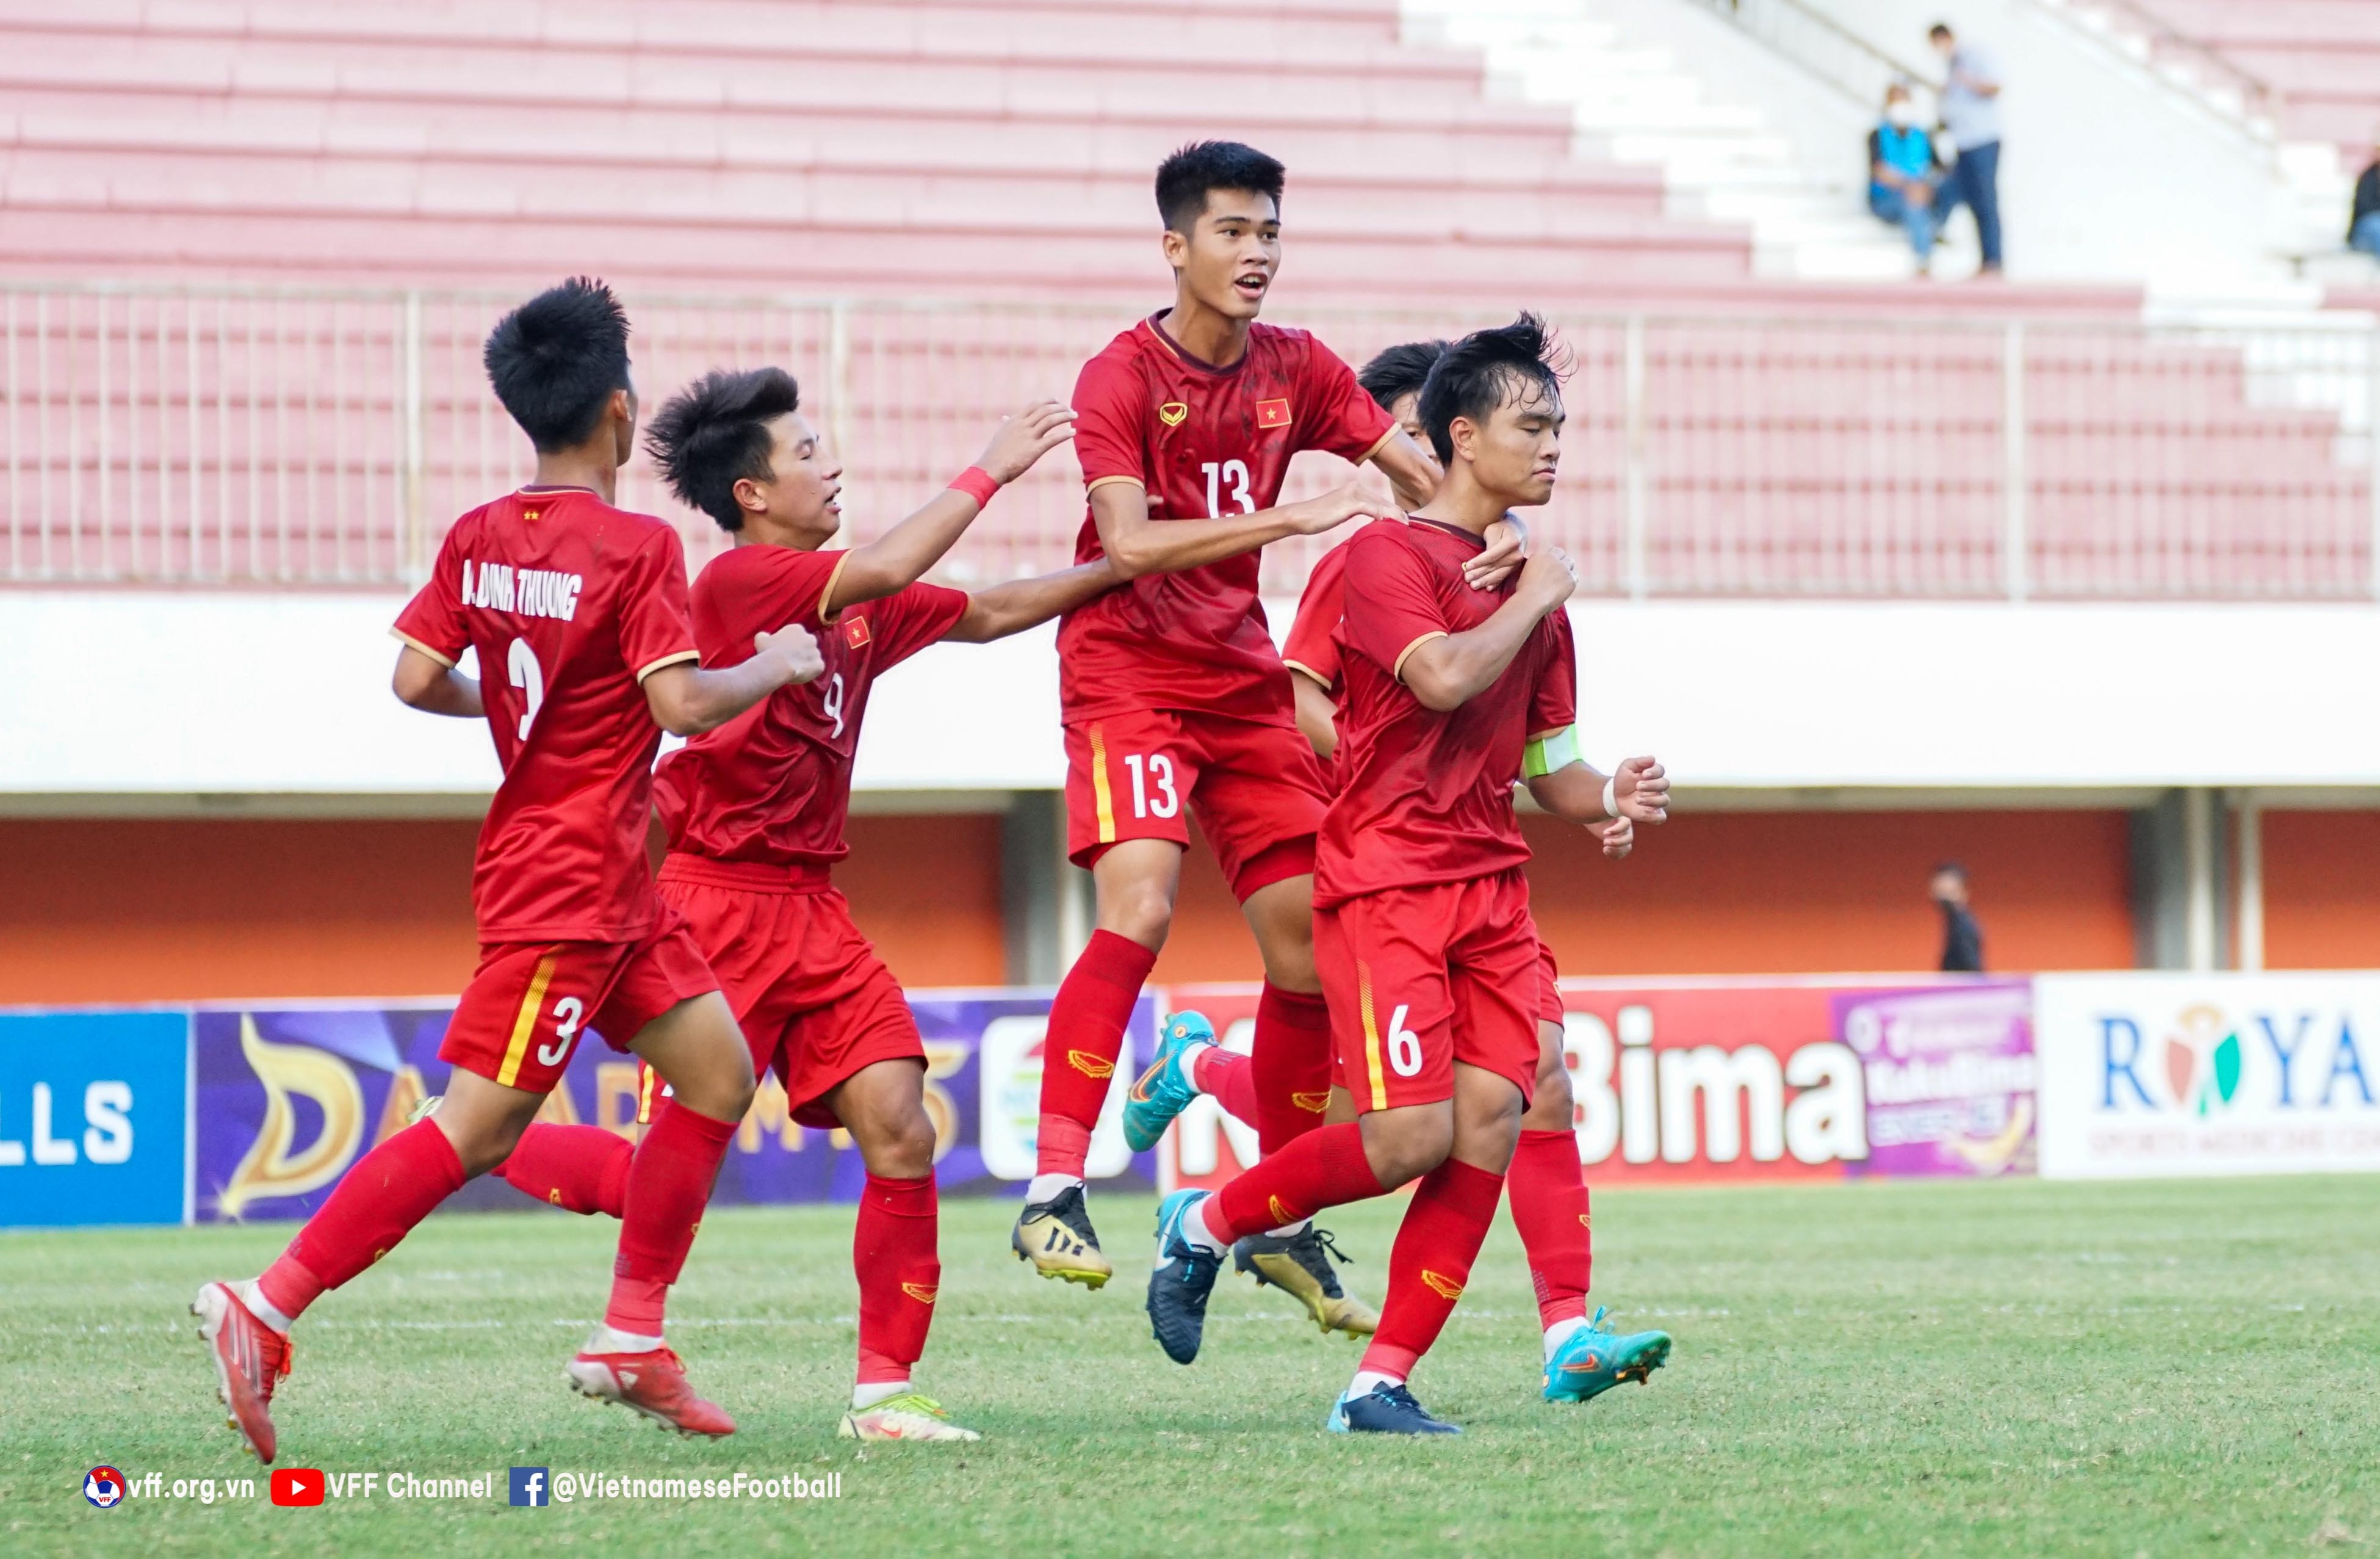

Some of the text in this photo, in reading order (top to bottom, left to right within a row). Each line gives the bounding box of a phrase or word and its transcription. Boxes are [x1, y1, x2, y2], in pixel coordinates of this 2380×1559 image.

[1201, 459, 1256, 519] 13
[824, 673, 843, 739] 9
[1125, 754, 1178, 819] 13
[537, 996, 583, 1066] 3
[1388, 1004, 1423, 1077] 6
